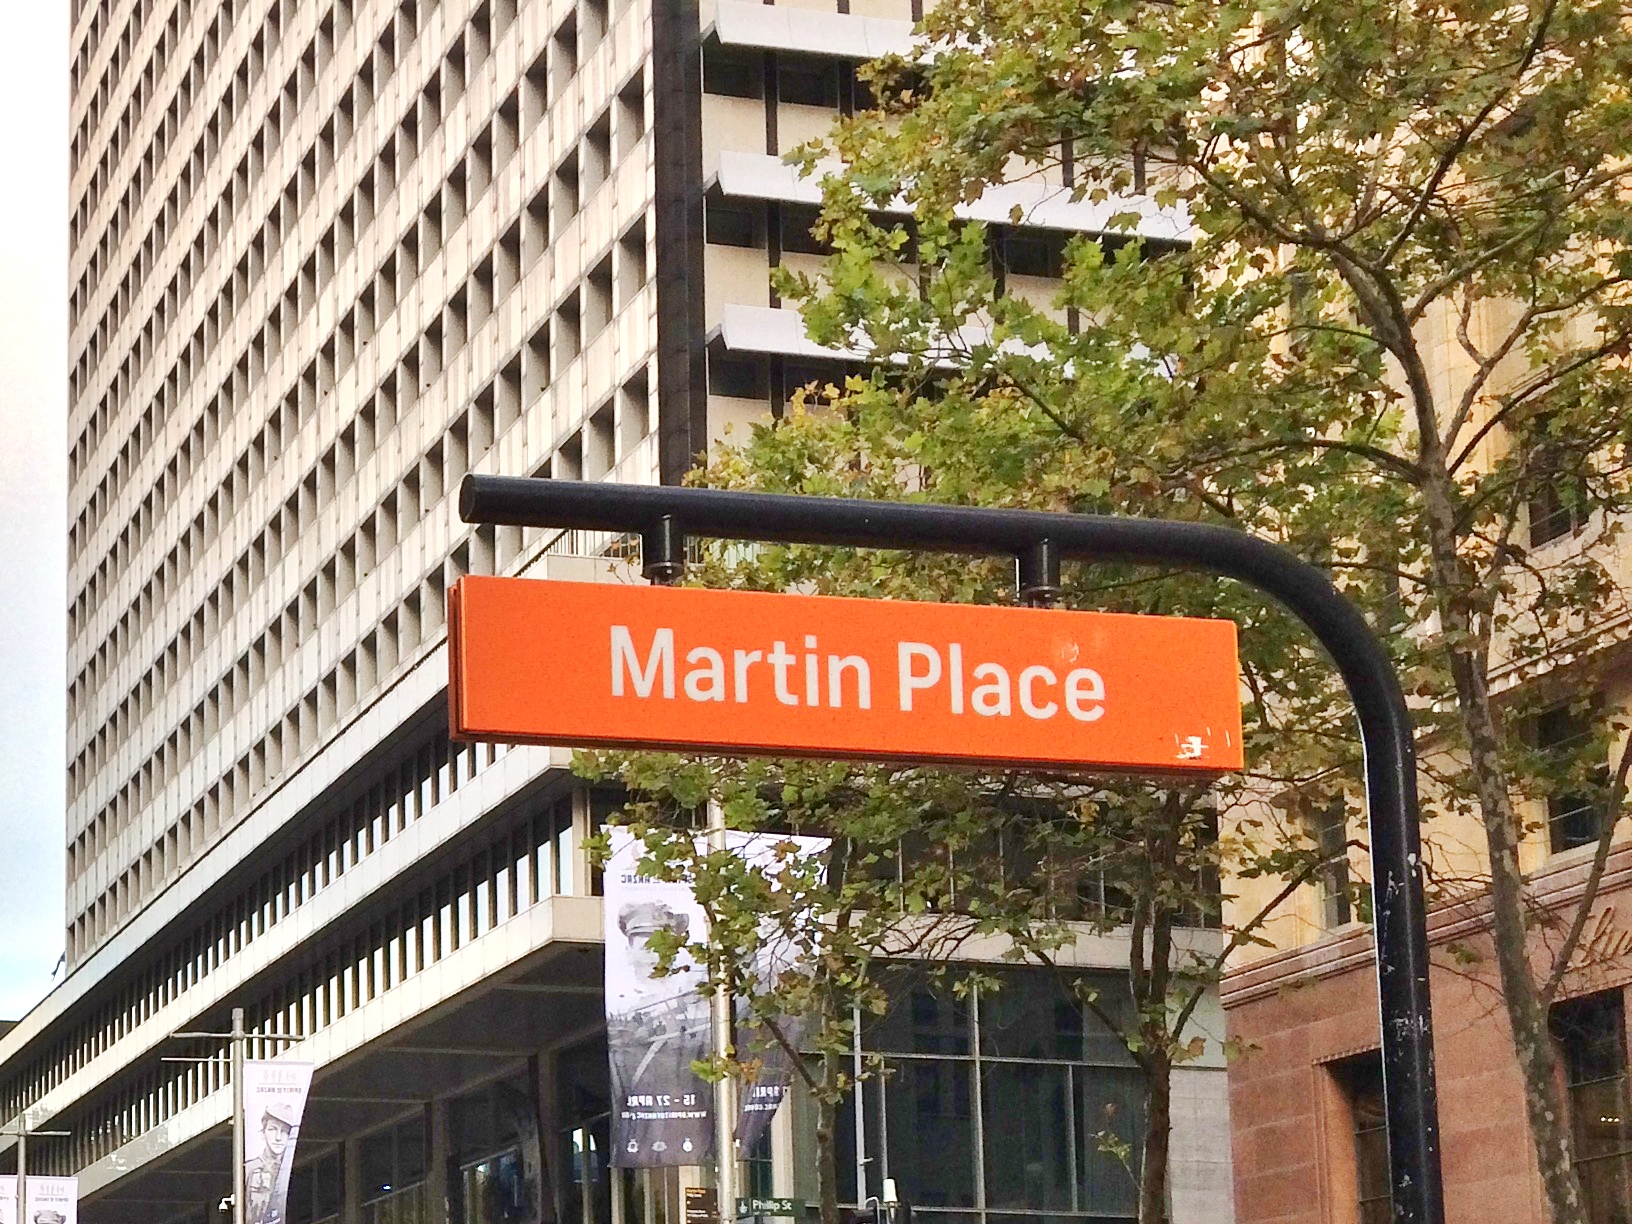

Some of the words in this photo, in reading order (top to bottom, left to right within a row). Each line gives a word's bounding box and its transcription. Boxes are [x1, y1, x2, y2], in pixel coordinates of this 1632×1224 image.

[610, 625, 870, 709] Martin
[898, 641, 1106, 721] Place
[752, 1200, 780, 1211] Phillip
[781, 1200, 793, 1211] St
